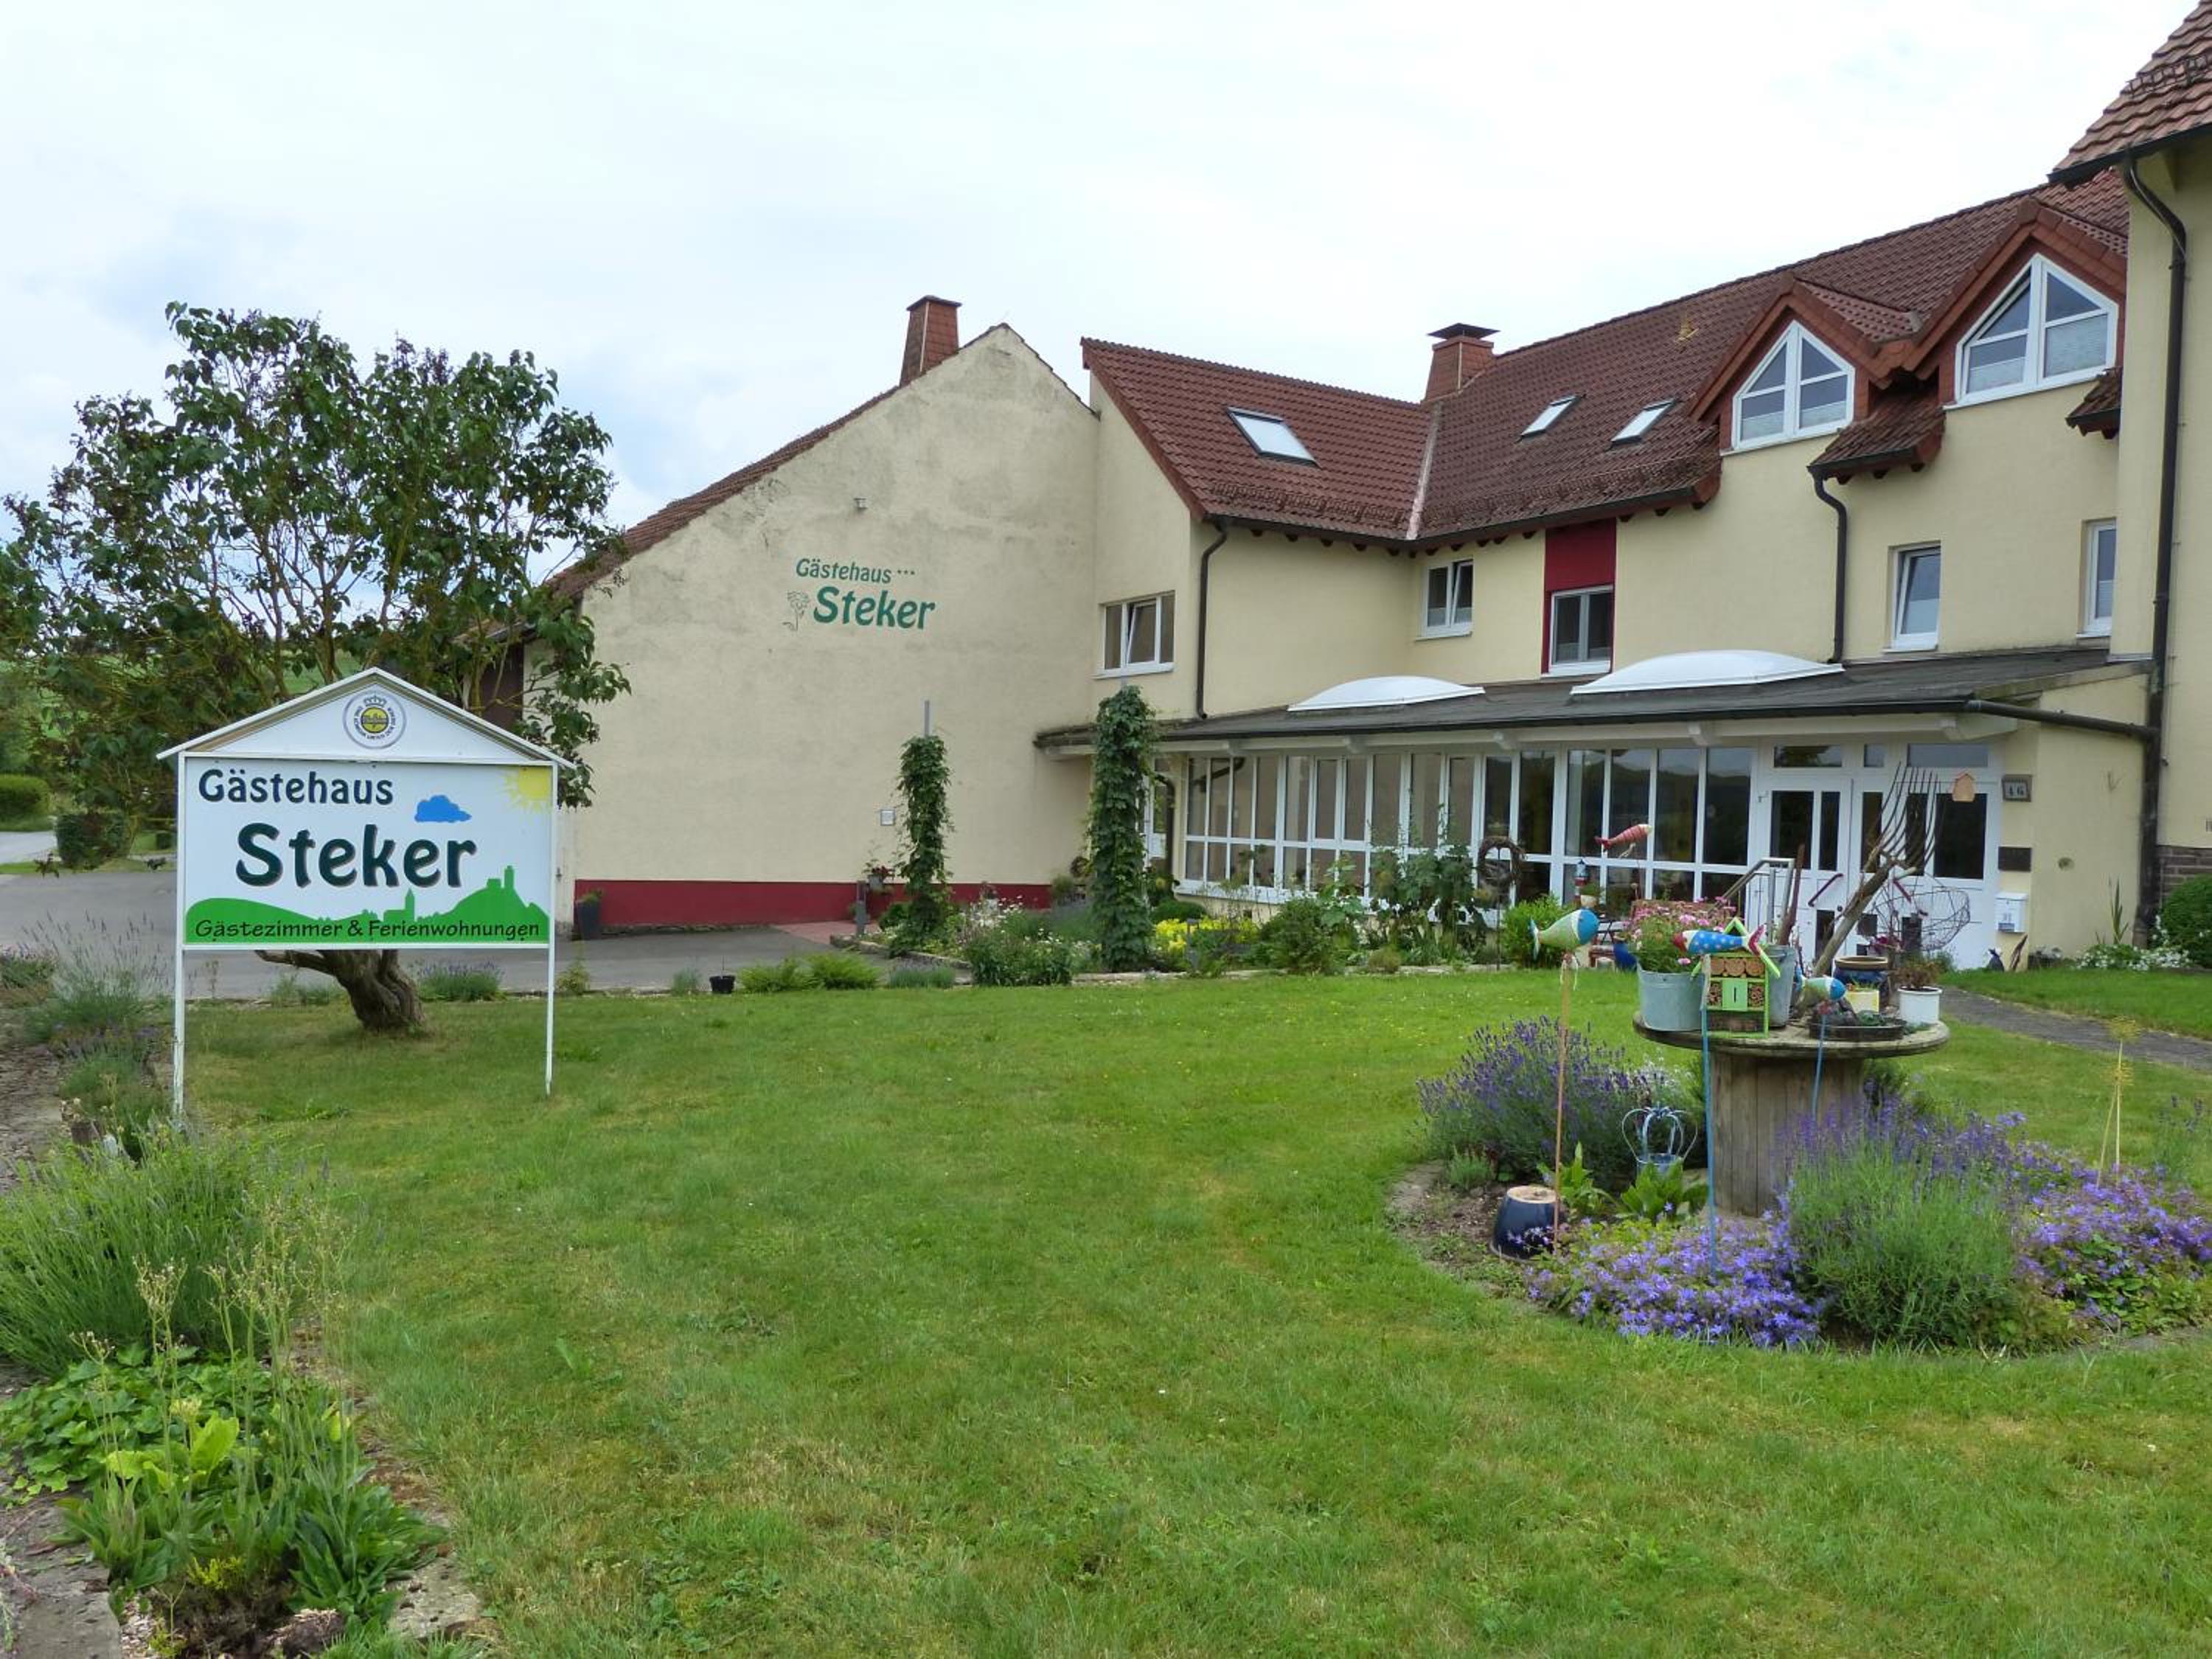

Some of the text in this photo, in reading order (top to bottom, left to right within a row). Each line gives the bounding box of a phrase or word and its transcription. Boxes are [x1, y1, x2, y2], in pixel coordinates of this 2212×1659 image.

[796, 558, 892, 583] Gästehaus
[813, 586, 936, 630] Steker
[198, 769, 393, 805] Gästehaus
[235, 822, 477, 888] Steker
[195, 919, 539, 940] Gästezimmer & Ferienwohnungen
